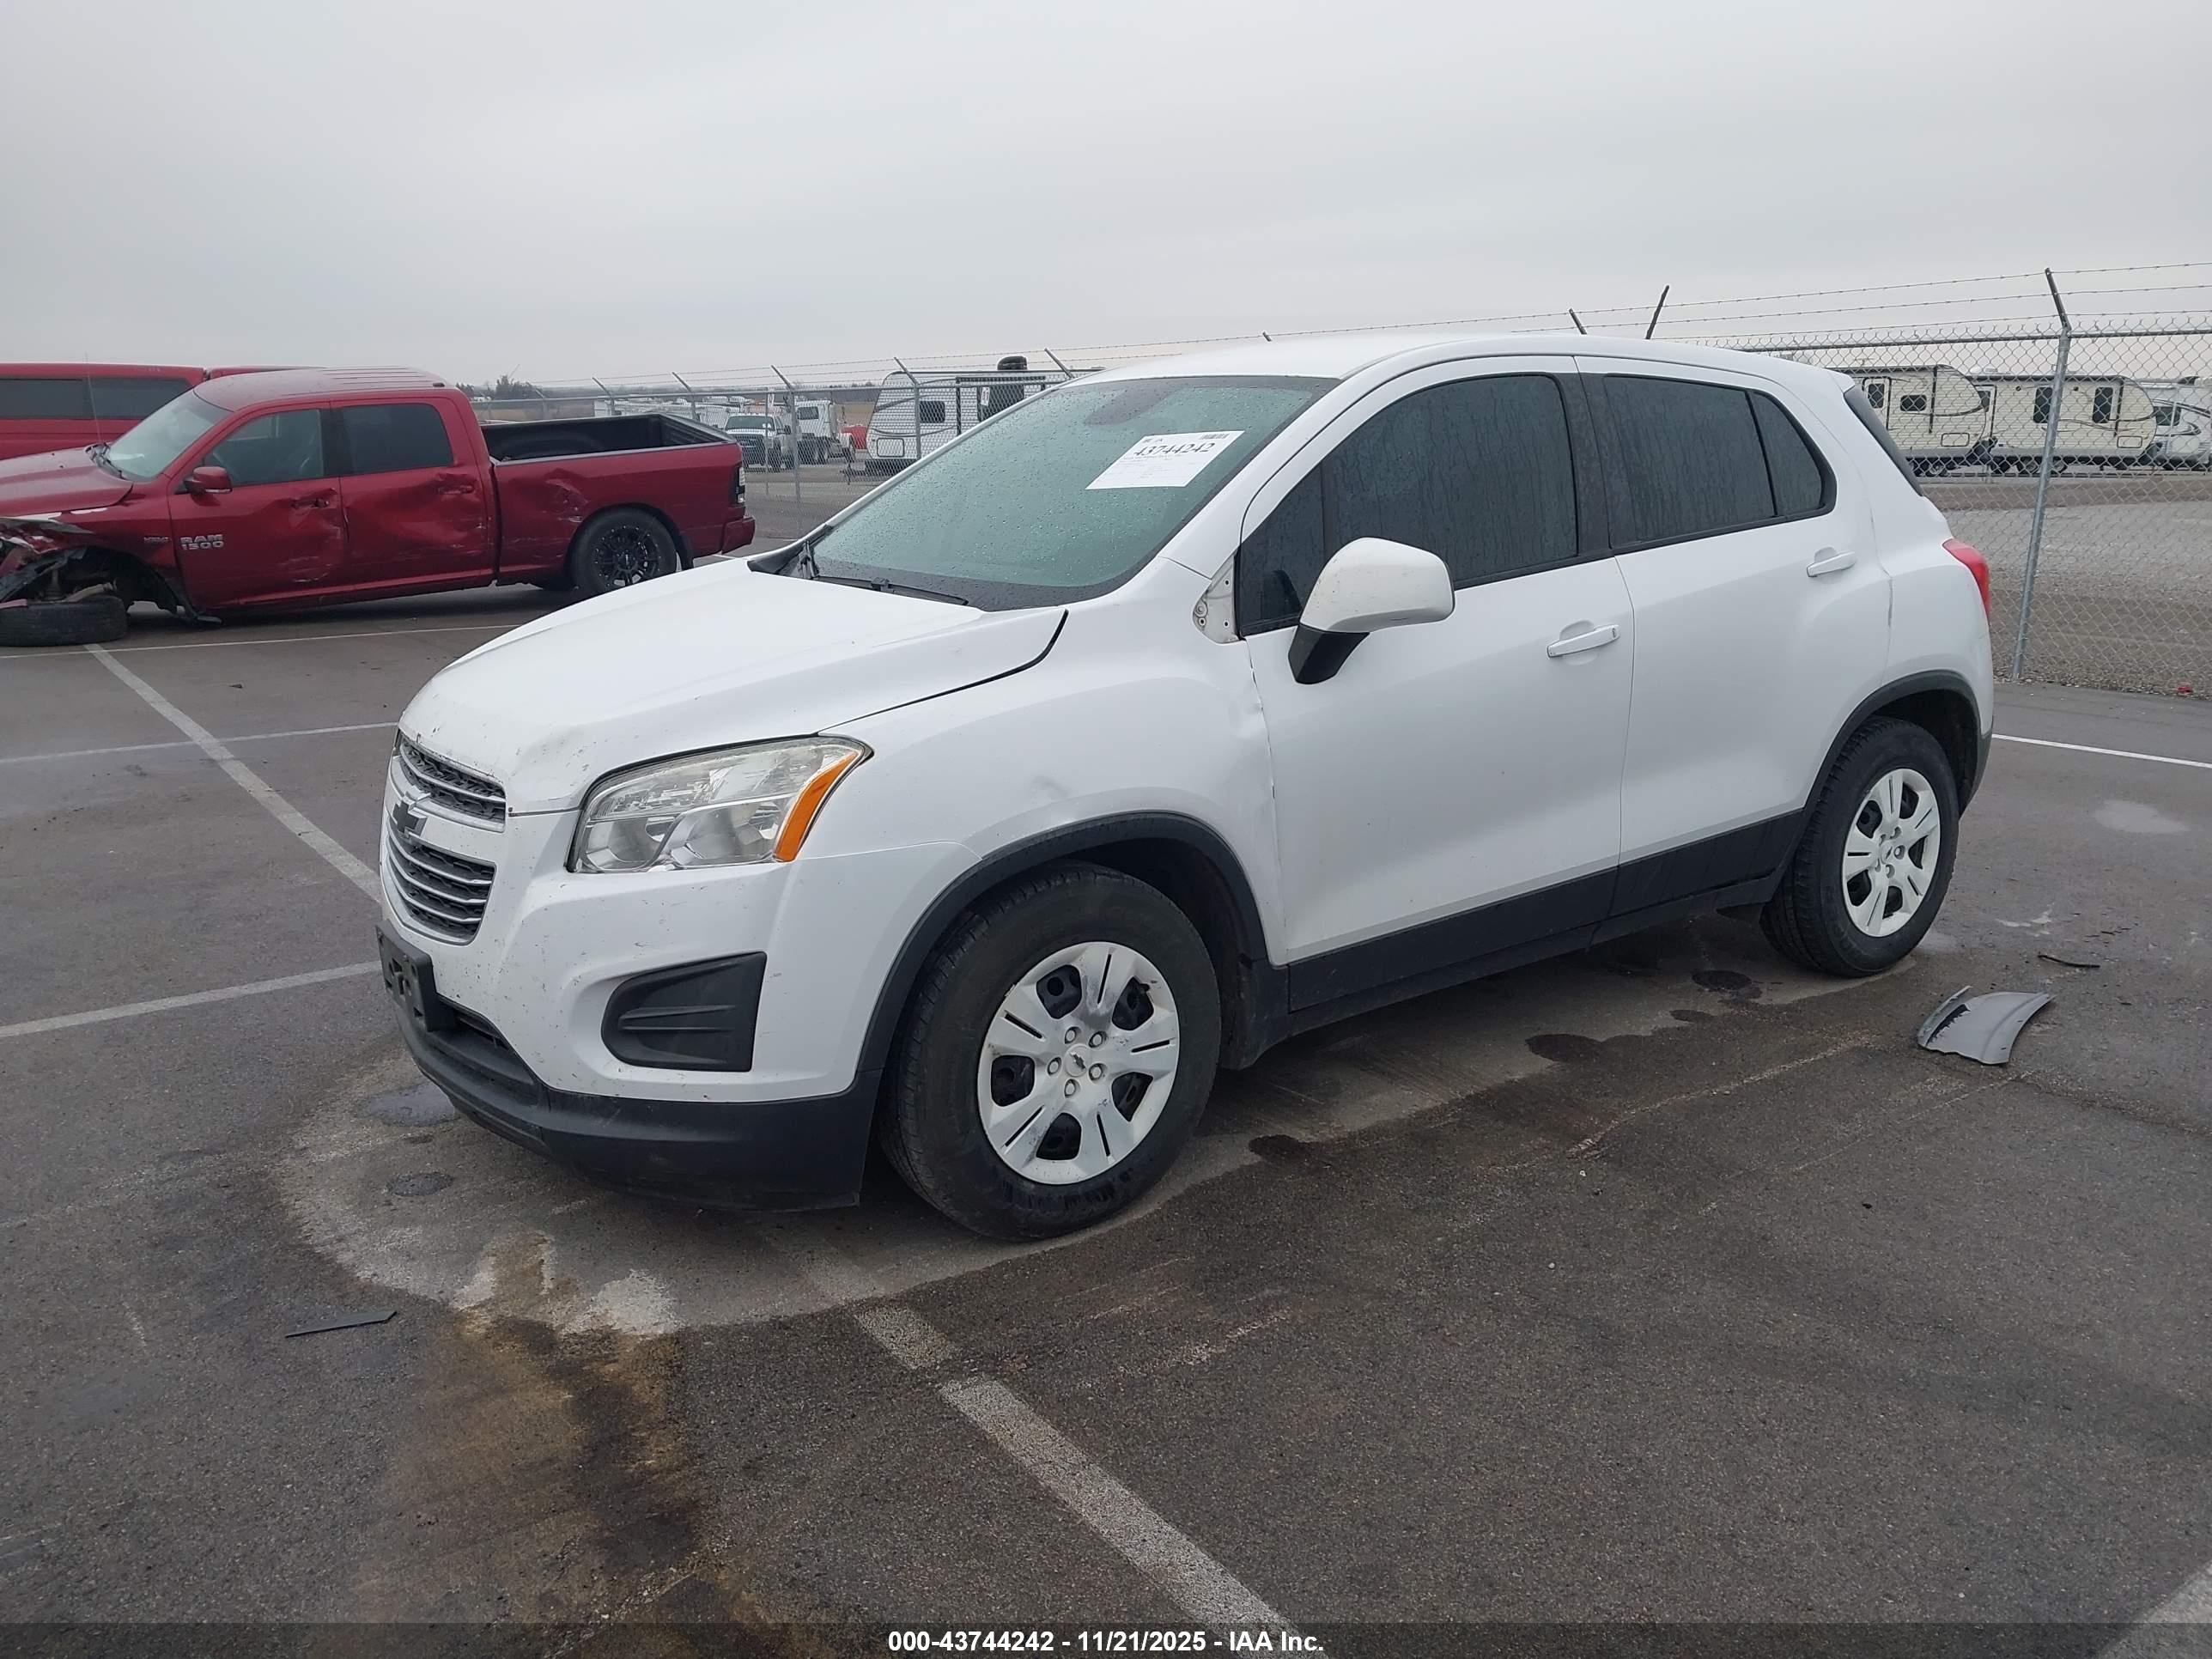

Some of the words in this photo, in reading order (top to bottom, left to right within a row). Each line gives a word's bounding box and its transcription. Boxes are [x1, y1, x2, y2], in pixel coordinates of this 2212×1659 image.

[1133, 442, 1216, 456] 43744242
[179, 534, 223, 544] RAM
[181, 541, 224, 550] 1500
